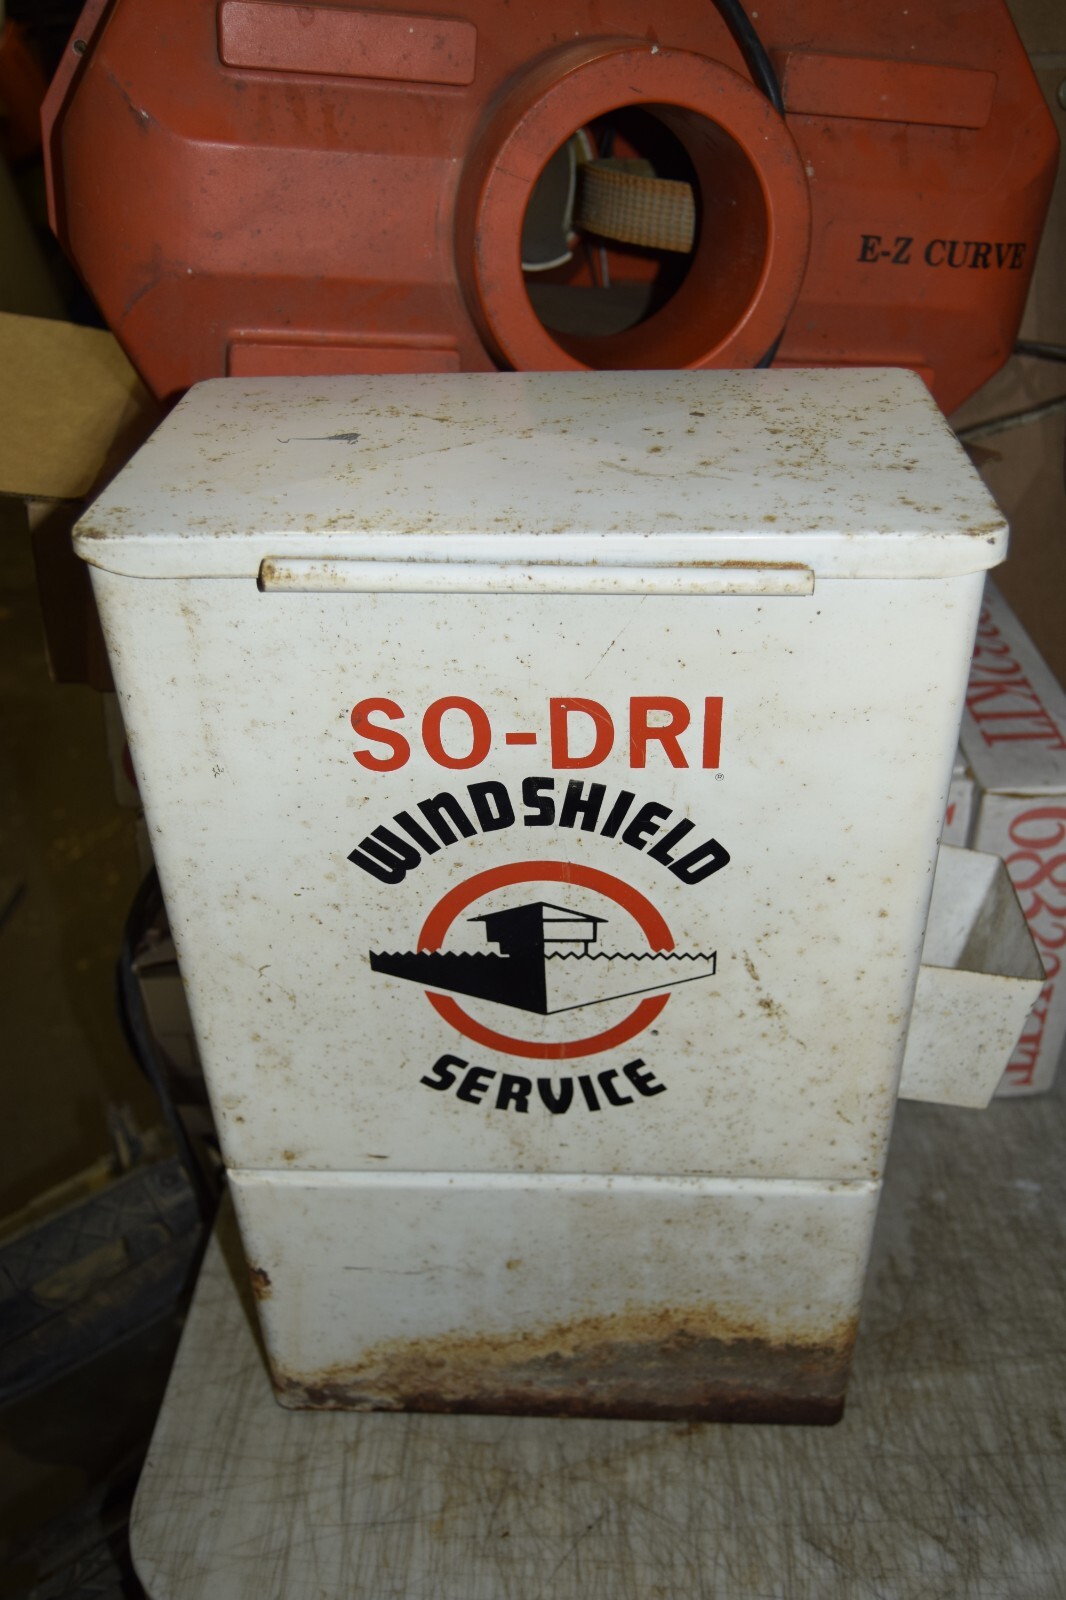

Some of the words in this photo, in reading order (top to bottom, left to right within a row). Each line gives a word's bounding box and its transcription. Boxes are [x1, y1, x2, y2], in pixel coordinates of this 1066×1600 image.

[857, 234, 913, 264] E-Z
[924, 239, 1027, 270] CURVE
[350, 695, 724, 772] SO-DRI
[347, 777, 730, 884] WINDSHIELD
[420, 1054, 667, 1114] SERVICE
